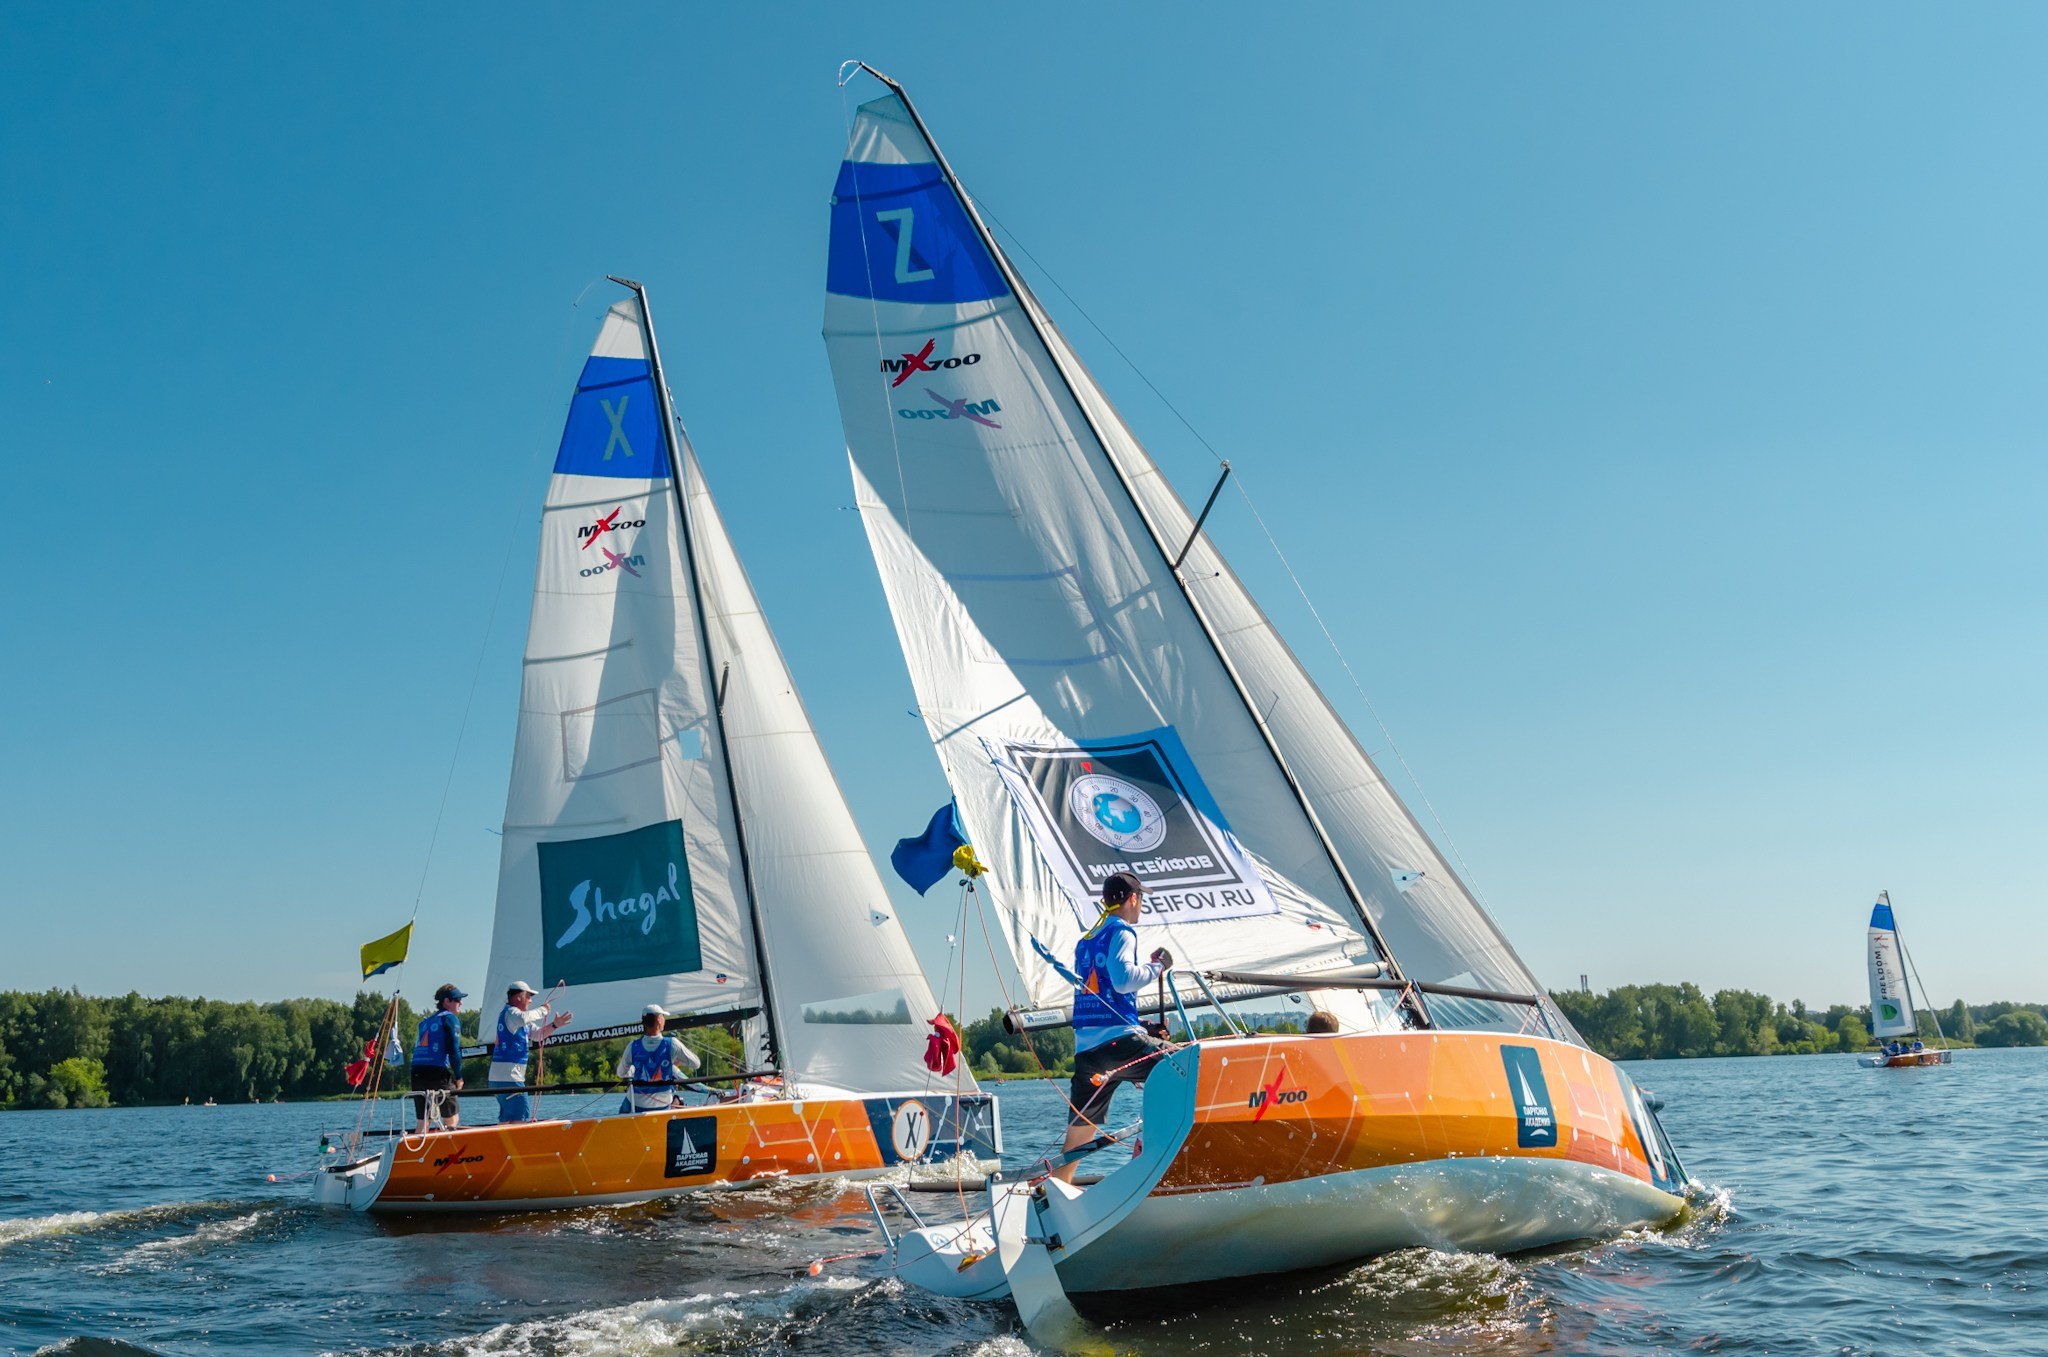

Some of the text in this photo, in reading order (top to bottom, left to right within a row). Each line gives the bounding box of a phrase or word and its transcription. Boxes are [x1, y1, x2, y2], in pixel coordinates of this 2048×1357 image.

[876, 207, 934, 284] Z
[881, 338, 981, 388] MX700
[600, 395, 634, 461] X
[577, 506, 646, 550] MX700
[1087, 855, 1214, 878] МИР СЕЙФОВ
[556, 862, 681, 949] Shagal
[592, 1024, 645, 1039] АКАДЕМИЯ
[1249, 1066, 1308, 1124] MX700
[905, 1112, 917, 1149] X
[434, 1145, 484, 1176] MX700
[675, 1158, 709, 1167] АКАДЕМИЯ
[676, 1152, 709, 1161] ПАРУСНАЯ
